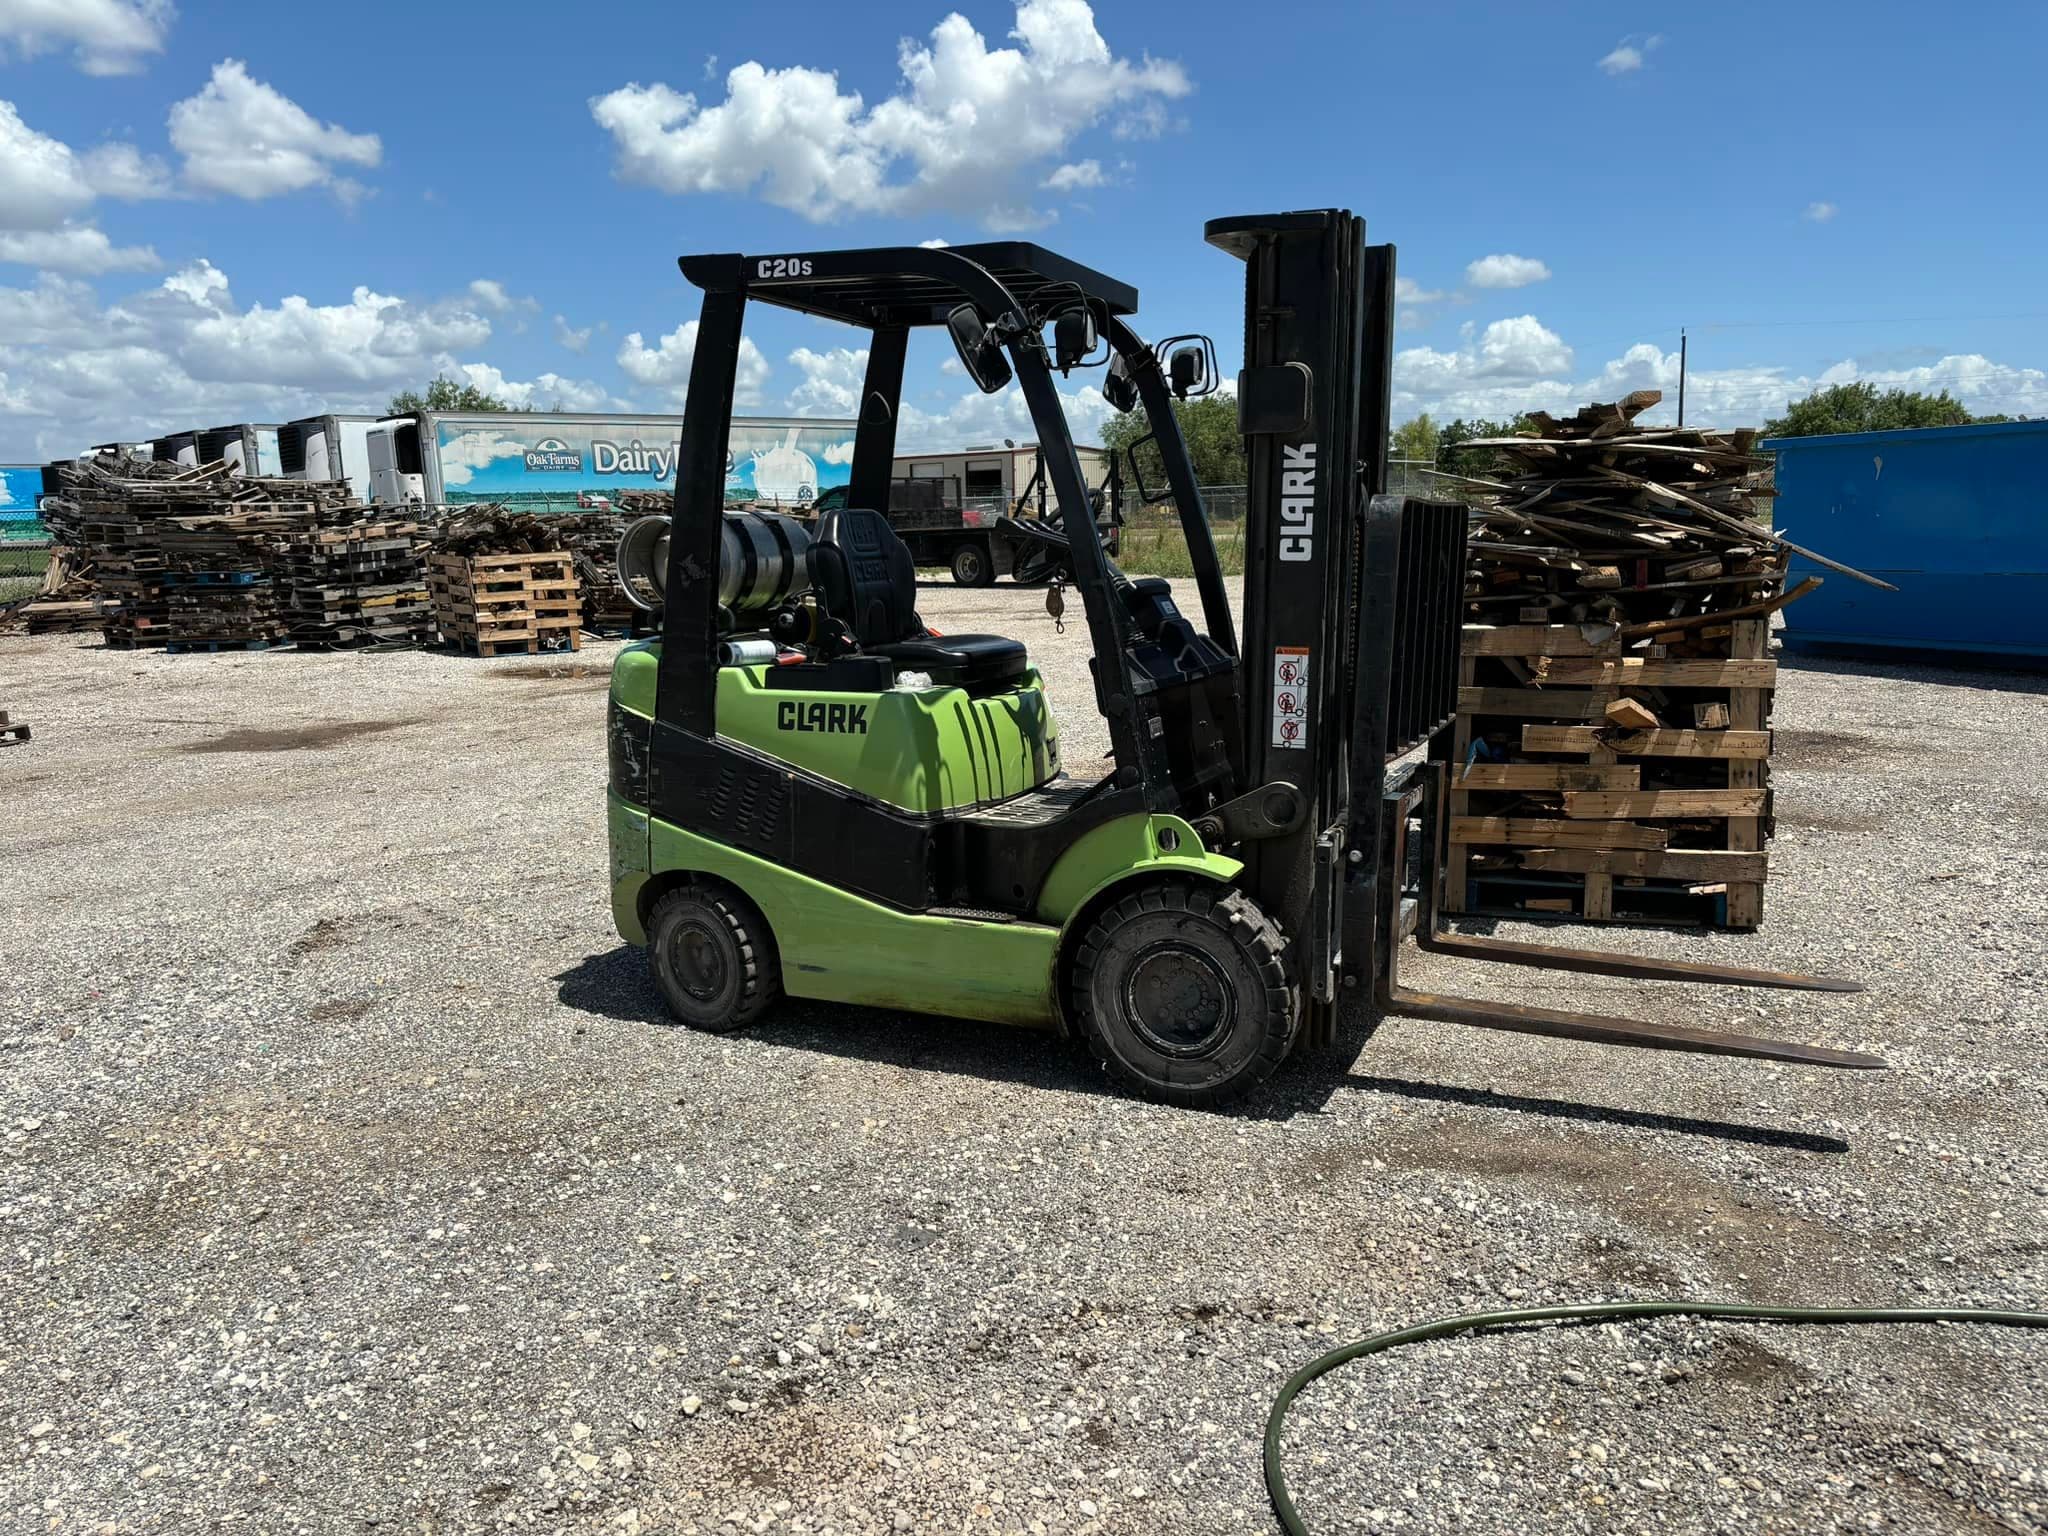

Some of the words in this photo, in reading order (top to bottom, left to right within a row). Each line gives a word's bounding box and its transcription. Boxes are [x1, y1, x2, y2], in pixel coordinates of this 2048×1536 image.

[758, 258, 813, 278] C20s
[527, 453, 548, 466] Oak
[547, 453, 580, 466] Farms
[1279, 443, 1317, 562] CLARK
[778, 702, 867, 734] CLARK
